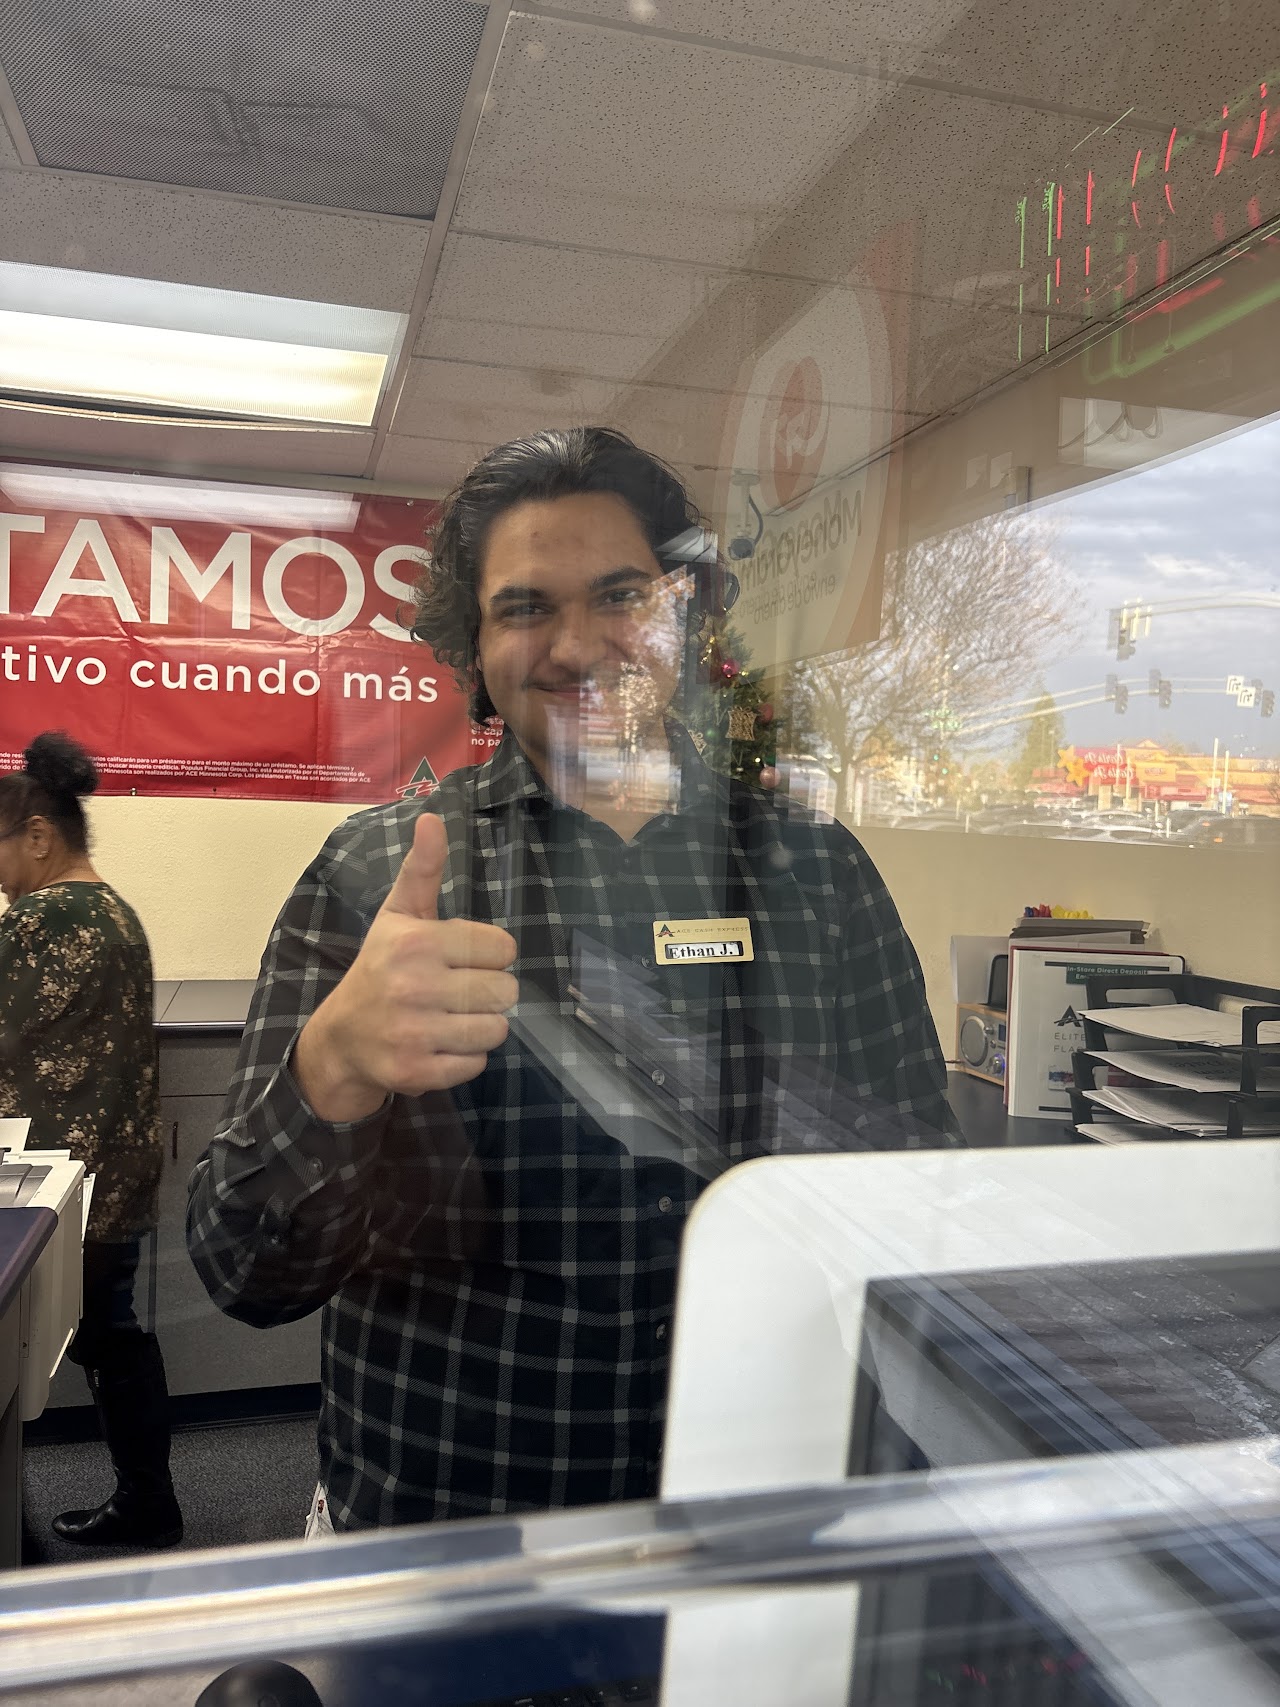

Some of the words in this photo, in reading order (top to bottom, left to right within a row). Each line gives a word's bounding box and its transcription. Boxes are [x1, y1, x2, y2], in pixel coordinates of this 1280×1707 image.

[1, 645, 107, 686] tivo
[130, 659, 321, 697] cuando
[343, 665, 438, 703] más
[471, 738, 485, 746] no
[669, 946, 715, 959] Ethan
[720, 943, 733, 956] J.
[1054, 1032, 1086, 1040] ELITE
